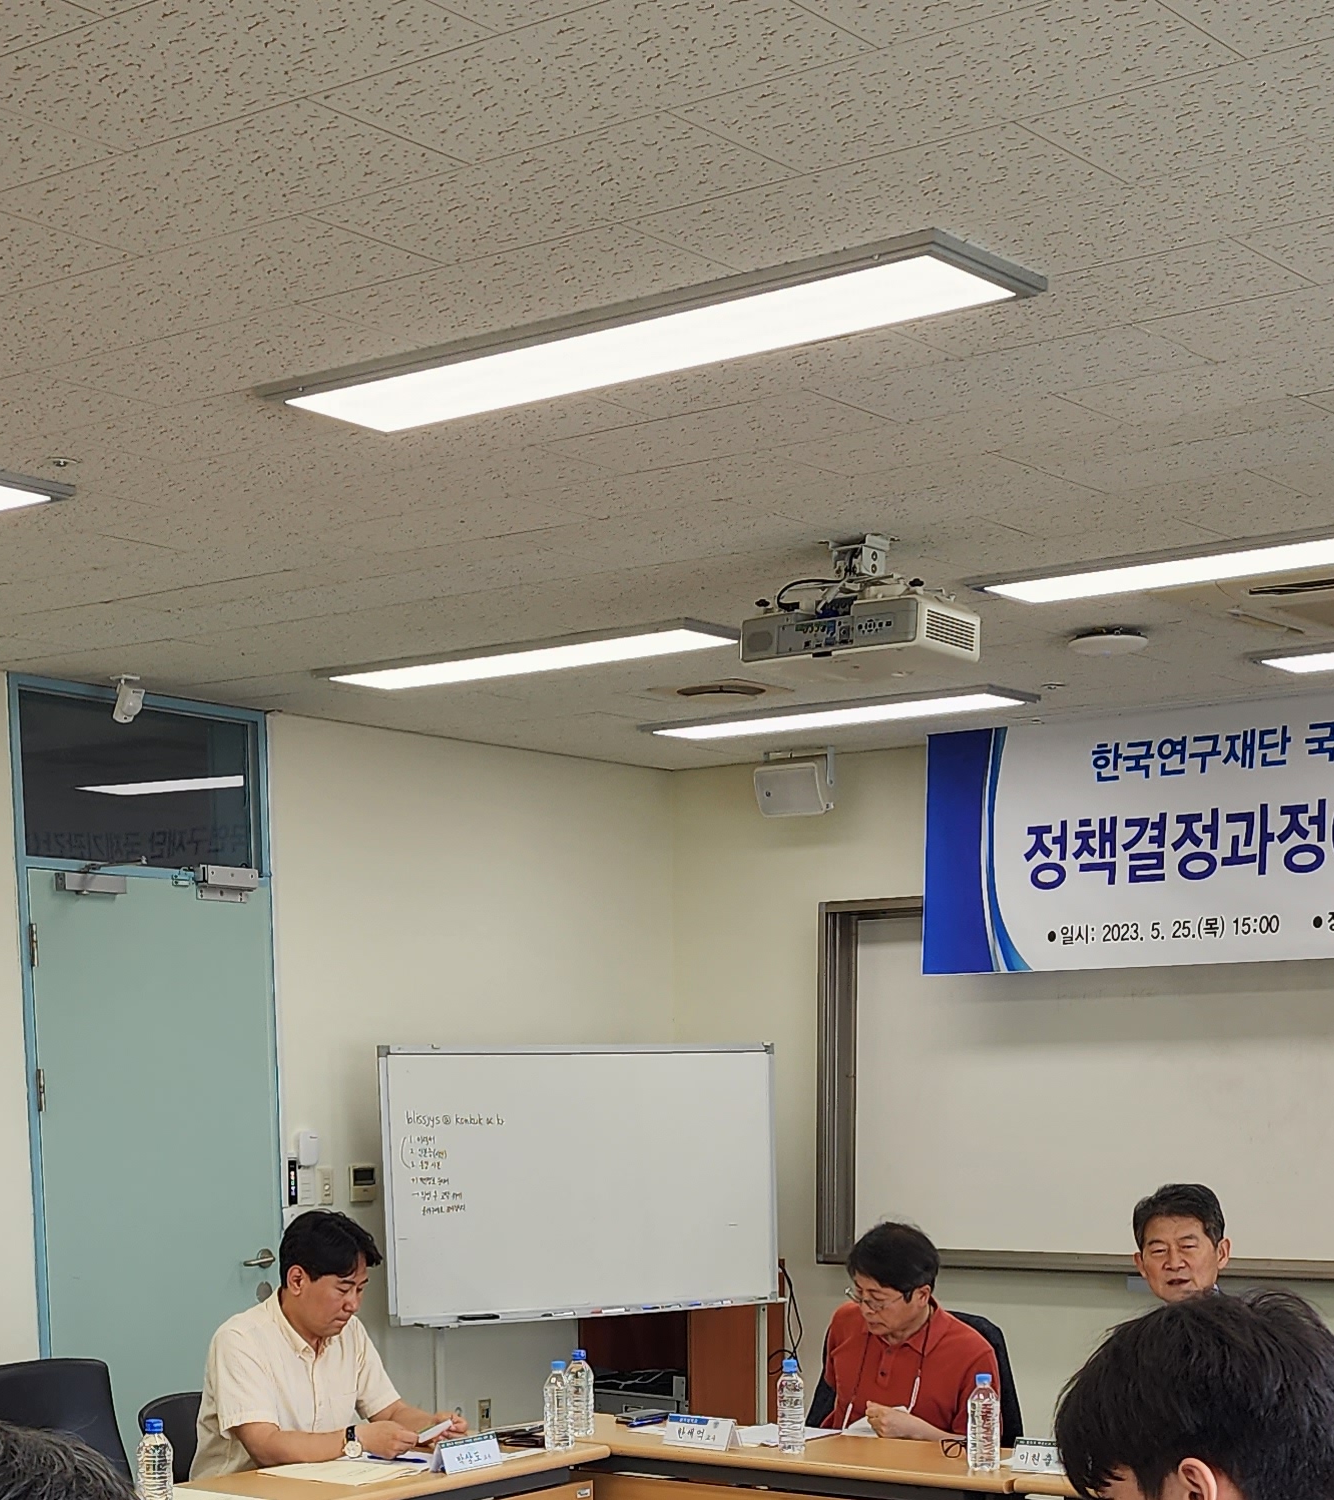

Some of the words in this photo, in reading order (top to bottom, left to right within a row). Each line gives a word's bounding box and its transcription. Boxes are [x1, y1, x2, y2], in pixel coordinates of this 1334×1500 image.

[1092, 725, 1291, 782] 한국연구재단
[1061, 925, 1094, 945] 일시:
[1103, 923, 1143, 942] 2023.
[1233, 915, 1279, 935] 15:00
